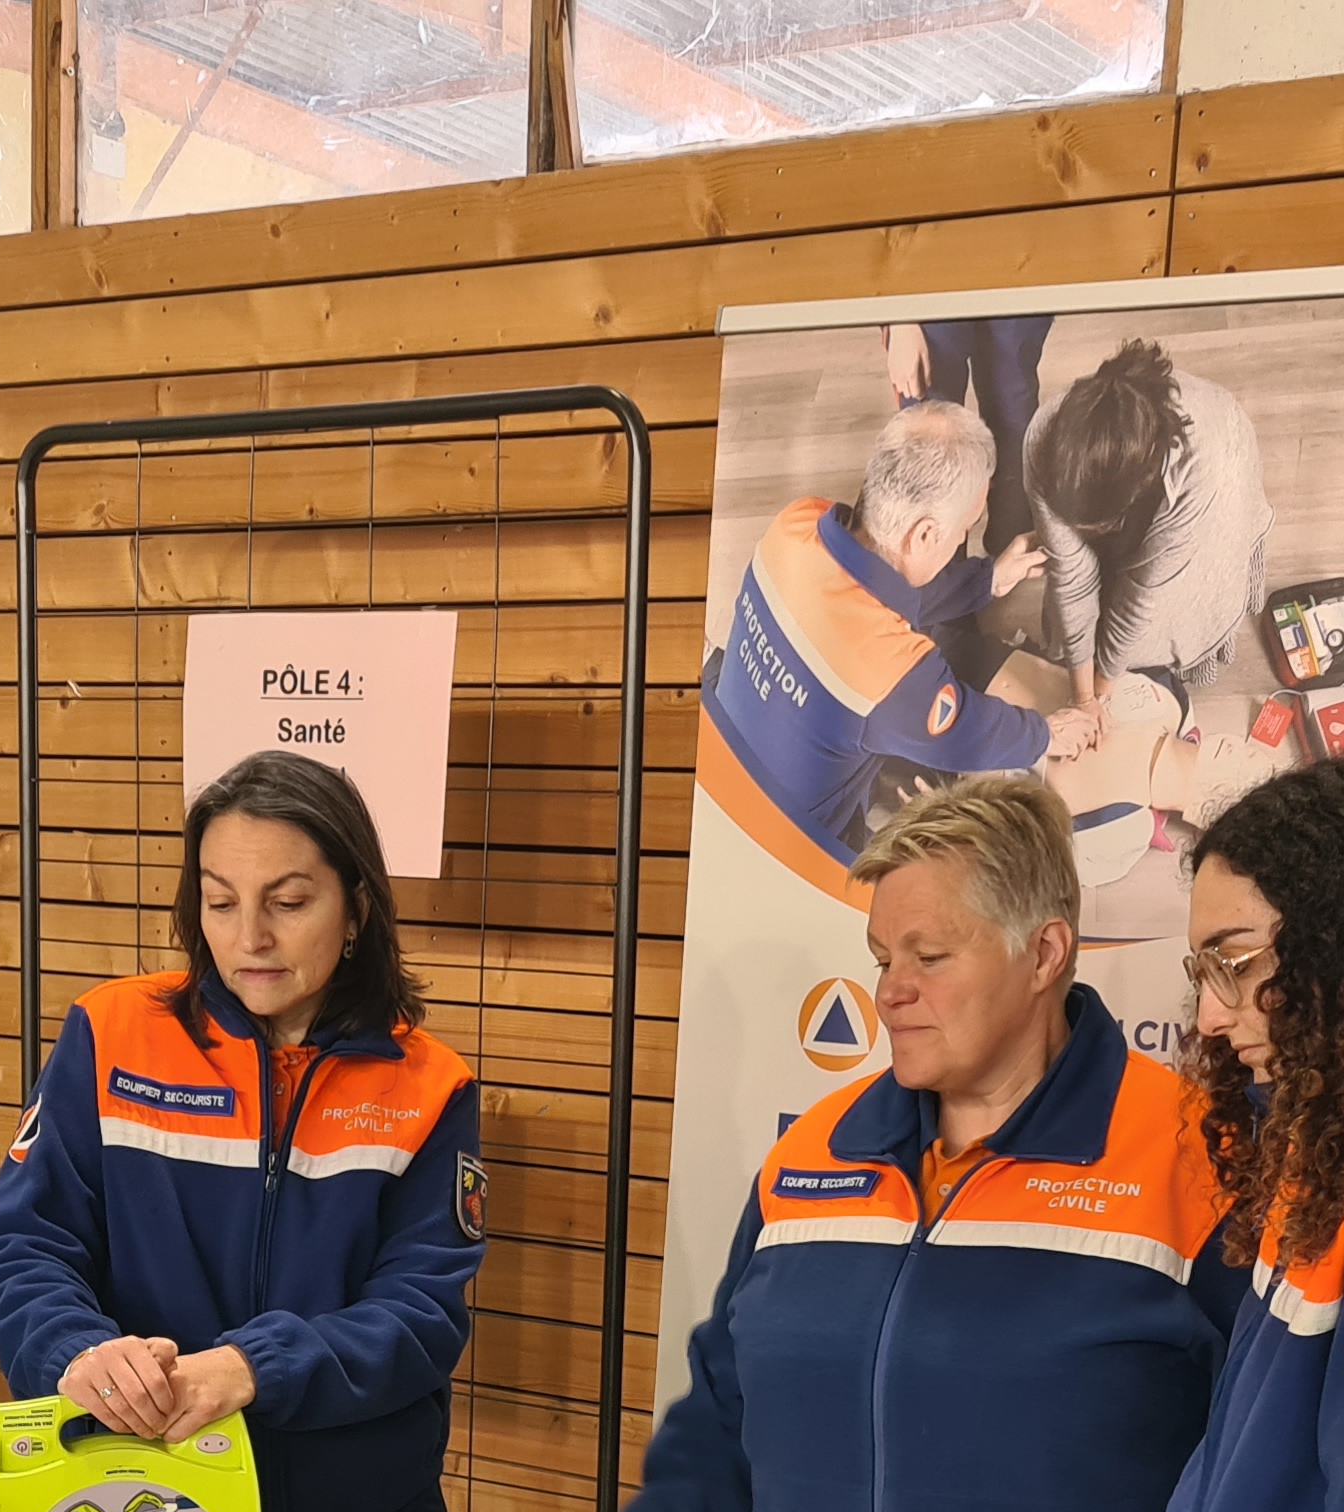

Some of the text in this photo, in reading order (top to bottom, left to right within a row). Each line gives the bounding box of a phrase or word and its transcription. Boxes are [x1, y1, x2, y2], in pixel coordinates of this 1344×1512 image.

[741, 592, 809, 708] PROTECTION
[262, 664, 330, 695] PÔLE
[337, 669, 351, 695] 4
[739, 639, 770, 702] CIVILE
[277, 717, 346, 744] Santé
[117, 1077, 225, 1107] EQUIPIER SECOURISTE
[321, 1102, 421, 1120] PROTECTION
[344, 1117, 394, 1134] CIVILE
[1025, 1176, 1142, 1198] PROTECTION
[1047, 1195, 1107, 1215] CIVILE
